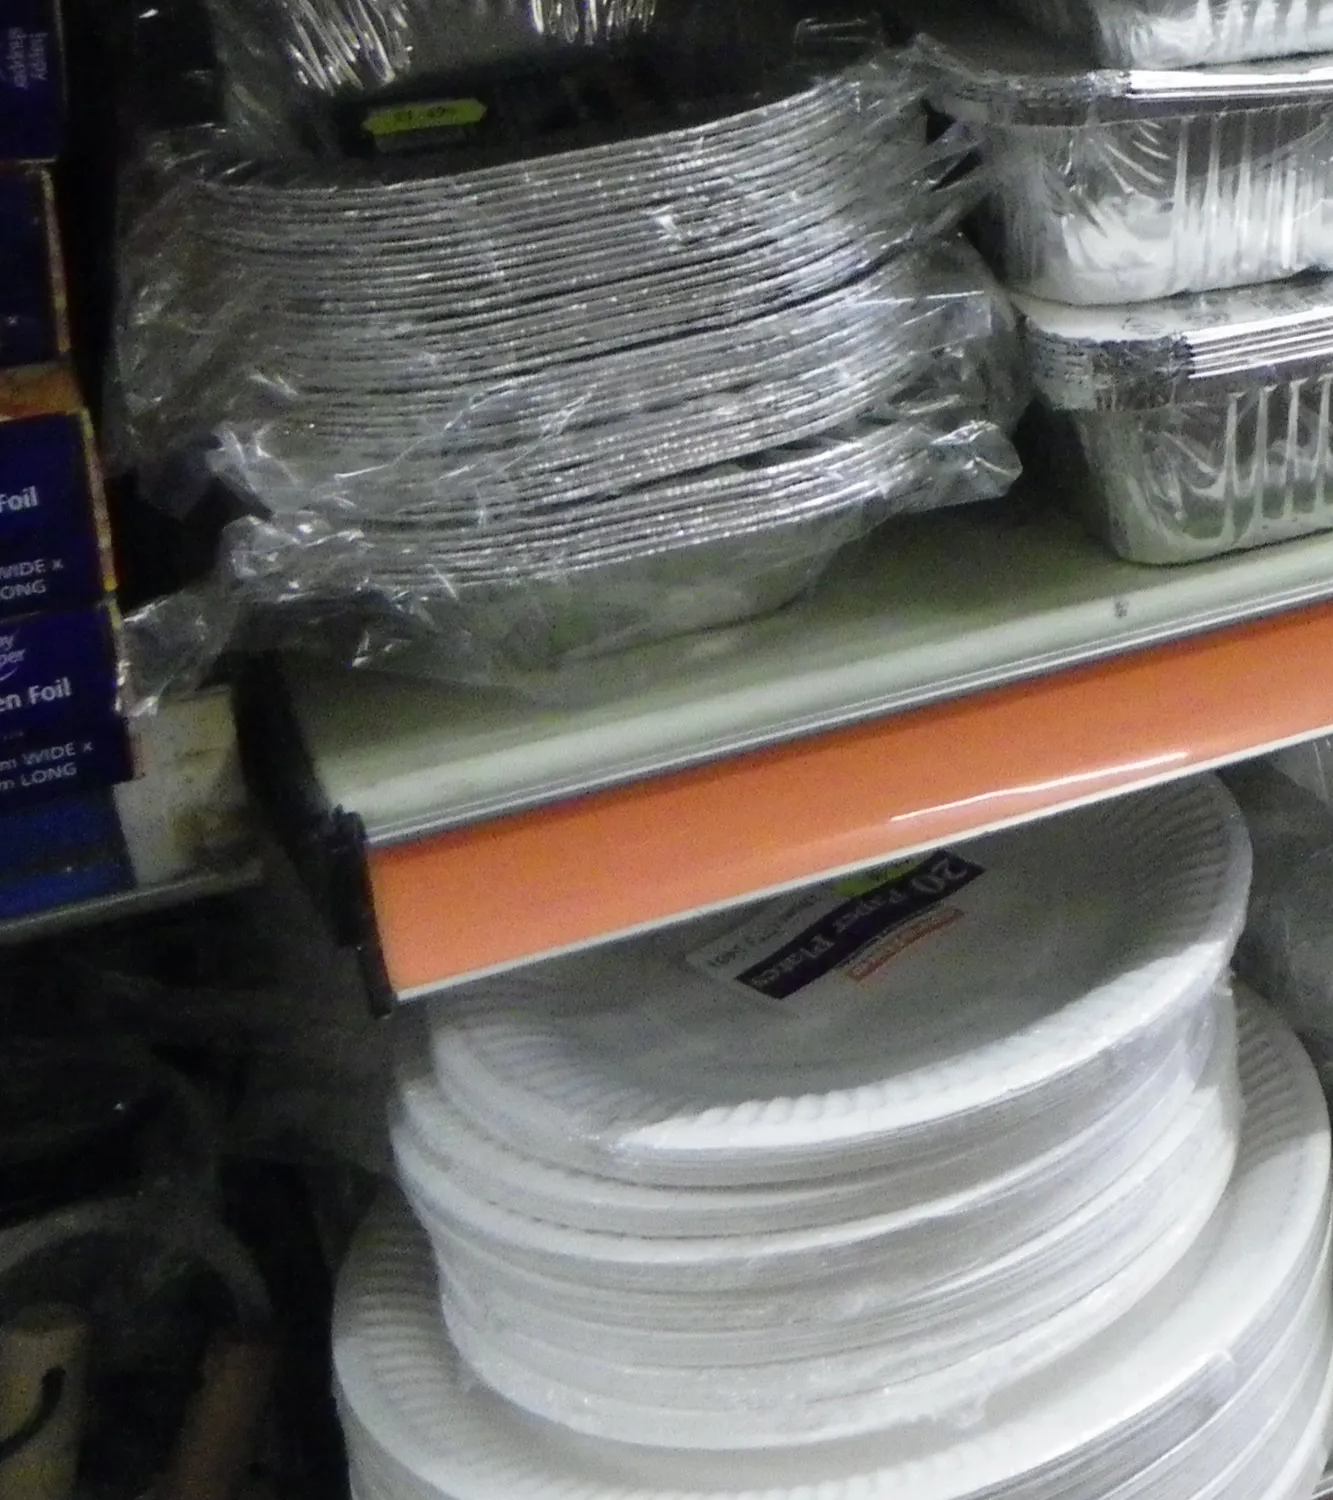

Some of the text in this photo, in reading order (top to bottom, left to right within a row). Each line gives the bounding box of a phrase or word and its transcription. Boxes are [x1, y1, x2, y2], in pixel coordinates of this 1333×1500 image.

[0, 580, 47, 601] ONG
[29, 676, 72, 706] Foil
[23, 742, 77, 766] WIDE
[21, 762, 78, 787] LONG
